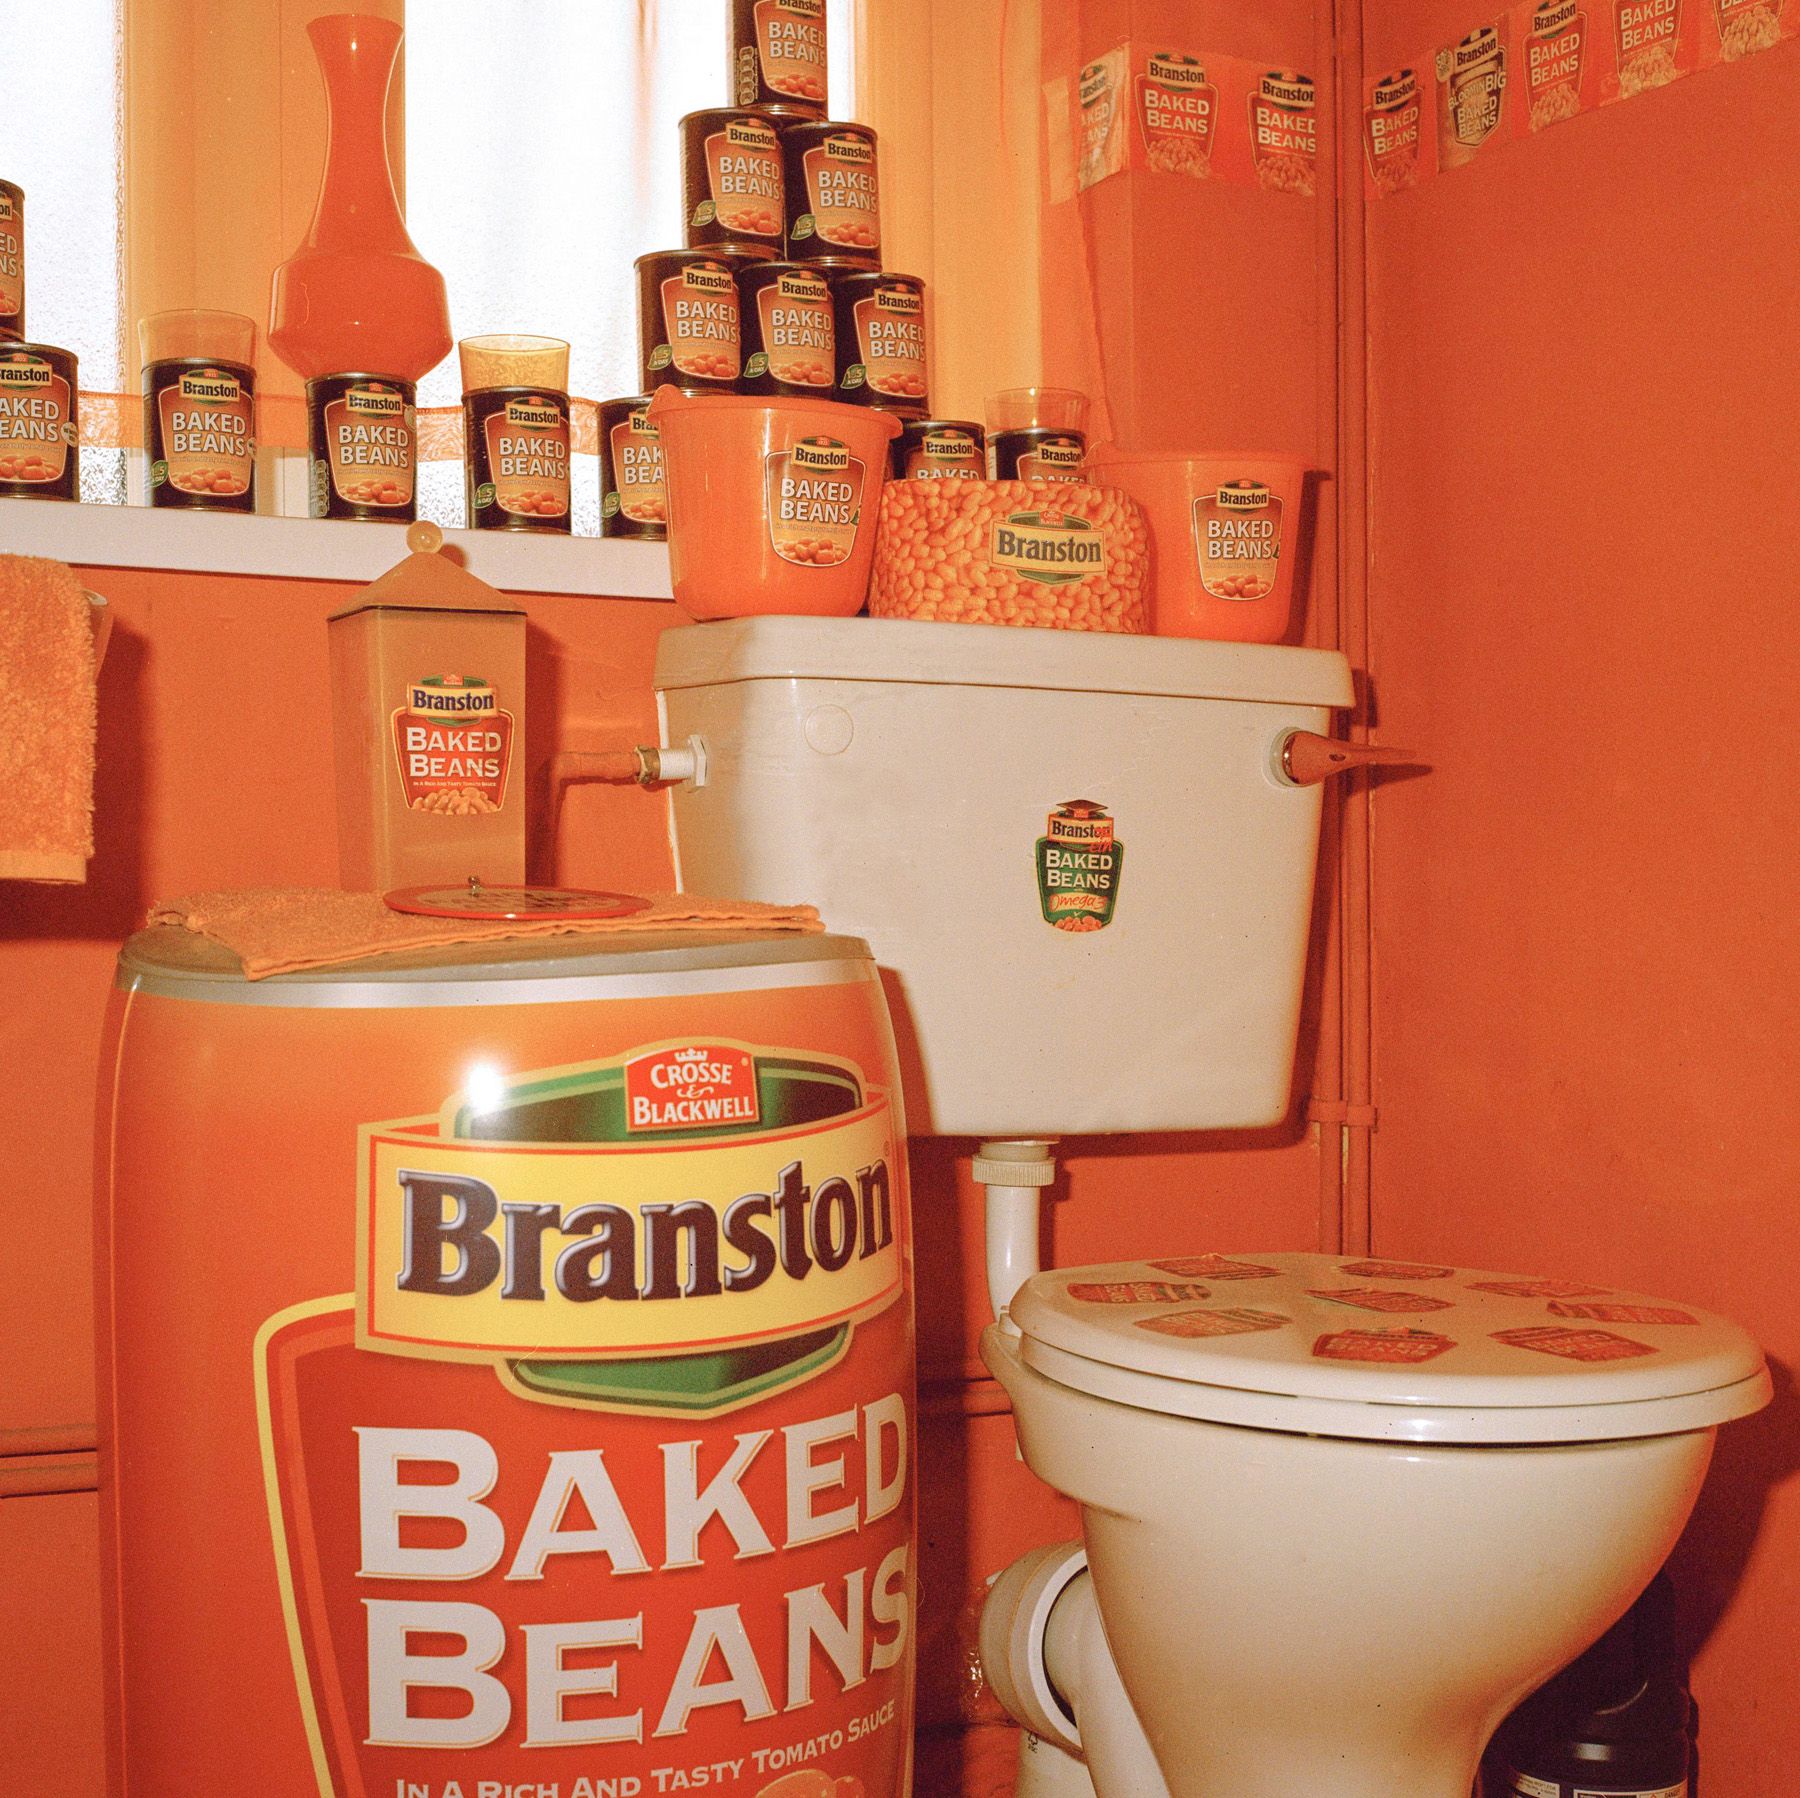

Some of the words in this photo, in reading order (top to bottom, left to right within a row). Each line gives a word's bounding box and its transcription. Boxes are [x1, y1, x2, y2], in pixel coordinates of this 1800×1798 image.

[1533, 3, 1576, 31] Branston
[1620, 0, 1676, 30] BAKED
[768, 21, 825, 47] BAKED
[1621, 16, 1675, 50] BEANS
[1456, 37, 1496, 66] Branston
[1529, 32, 1580, 67] BAKED
[1149, 61, 1206, 83] Branston
[1486, 70, 1507, 93] BIG
[1530, 54, 1579, 87] BEANS
[1144, 88, 1210, 116] BAKED
[1375, 79, 1415, 105] Branston
[1457, 95, 1497, 123] BAKED
[1146, 109, 1208, 134] BEANS
[1371, 107, 1419, 137] BAKED
[1458, 111, 1497, 139] BEANS
[729, 128, 775, 148] Branston
[1257, 127, 1316, 153] BEANS
[1374, 126, 1418, 155] BEANS
[827, 142, 871, 160] Branston
[719, 156, 779, 181] BAKED
[721, 175, 780, 200] BEANS
[817, 169, 876, 194] BAKED
[819, 189, 877, 213] BEANS
[686, 272, 732, 290] Branston
[781, 281, 827, 298] Branston
[675, 300, 737, 324] BAKED
[877, 293, 920, 311] Branston
[676, 320, 737, 344] BEANS
[770, 309, 832, 331] BAKED
[867, 321, 925, 343] BAKED
[772, 328, 832, 351] BEANS
[869, 340, 926, 362] BEANS
[0, 363, 50, 383] ranston
[182, 380, 238, 399] Branston
[0, 397, 60, 421] AKED
[348, 394, 401, 412] Branston
[171, 412, 246, 436] BAKED
[509, 407, 560, 424] Branston
[0, 419, 59, 443] EANS
[338, 424, 408, 448] BAKED
[172, 432, 247, 458] BEANS
[499, 437, 566, 459] BAKED
[622, 446, 664, 465] BAK
[794, 446, 848, 467] Branston
[925, 441, 973, 455] Branston
[1040, 448, 1081, 463] Branston
[339, 445, 409, 470] BEANS
[500, 457, 566, 480] BEANS
[624, 465, 665, 485] BEA
[780, 477, 853, 503] BAKED
[1219, 491, 1267, 506] Branston
[780, 499, 850, 525] BEANS
[1207, 519, 1274, 539] BAKED
[996, 528, 1102, 564] Branston
[1207, 540, 1273, 560] BEANS
[412, 688, 495, 712] Branston
[406, 726, 502, 753] BAKED
[409, 753, 500, 778] BEANS
[1046, 848, 1113, 871] BAKED
[1047, 868, 1111, 890] BEANS
[650, 1062, 733, 1089] CROSSE
[676, 1084, 715, 1100] &
[632, 1095, 755, 1126] BLACKWELL
[395, 1156, 894, 1304] Branston
[350, 1391, 909, 1583] BAKED
[359, 1541, 914, 1752] BEANS
[396, 1778, 430, 1798] IN
[441, 1780, 464, 1798] A
[477, 1780, 559, 1798] RICH
[570, 1776, 641, 1798] AND
[650, 1758, 745, 1793] TASTY
[751, 1729, 844, 1774] TOMATO
[847, 1698, 896, 1743] SAUCE
